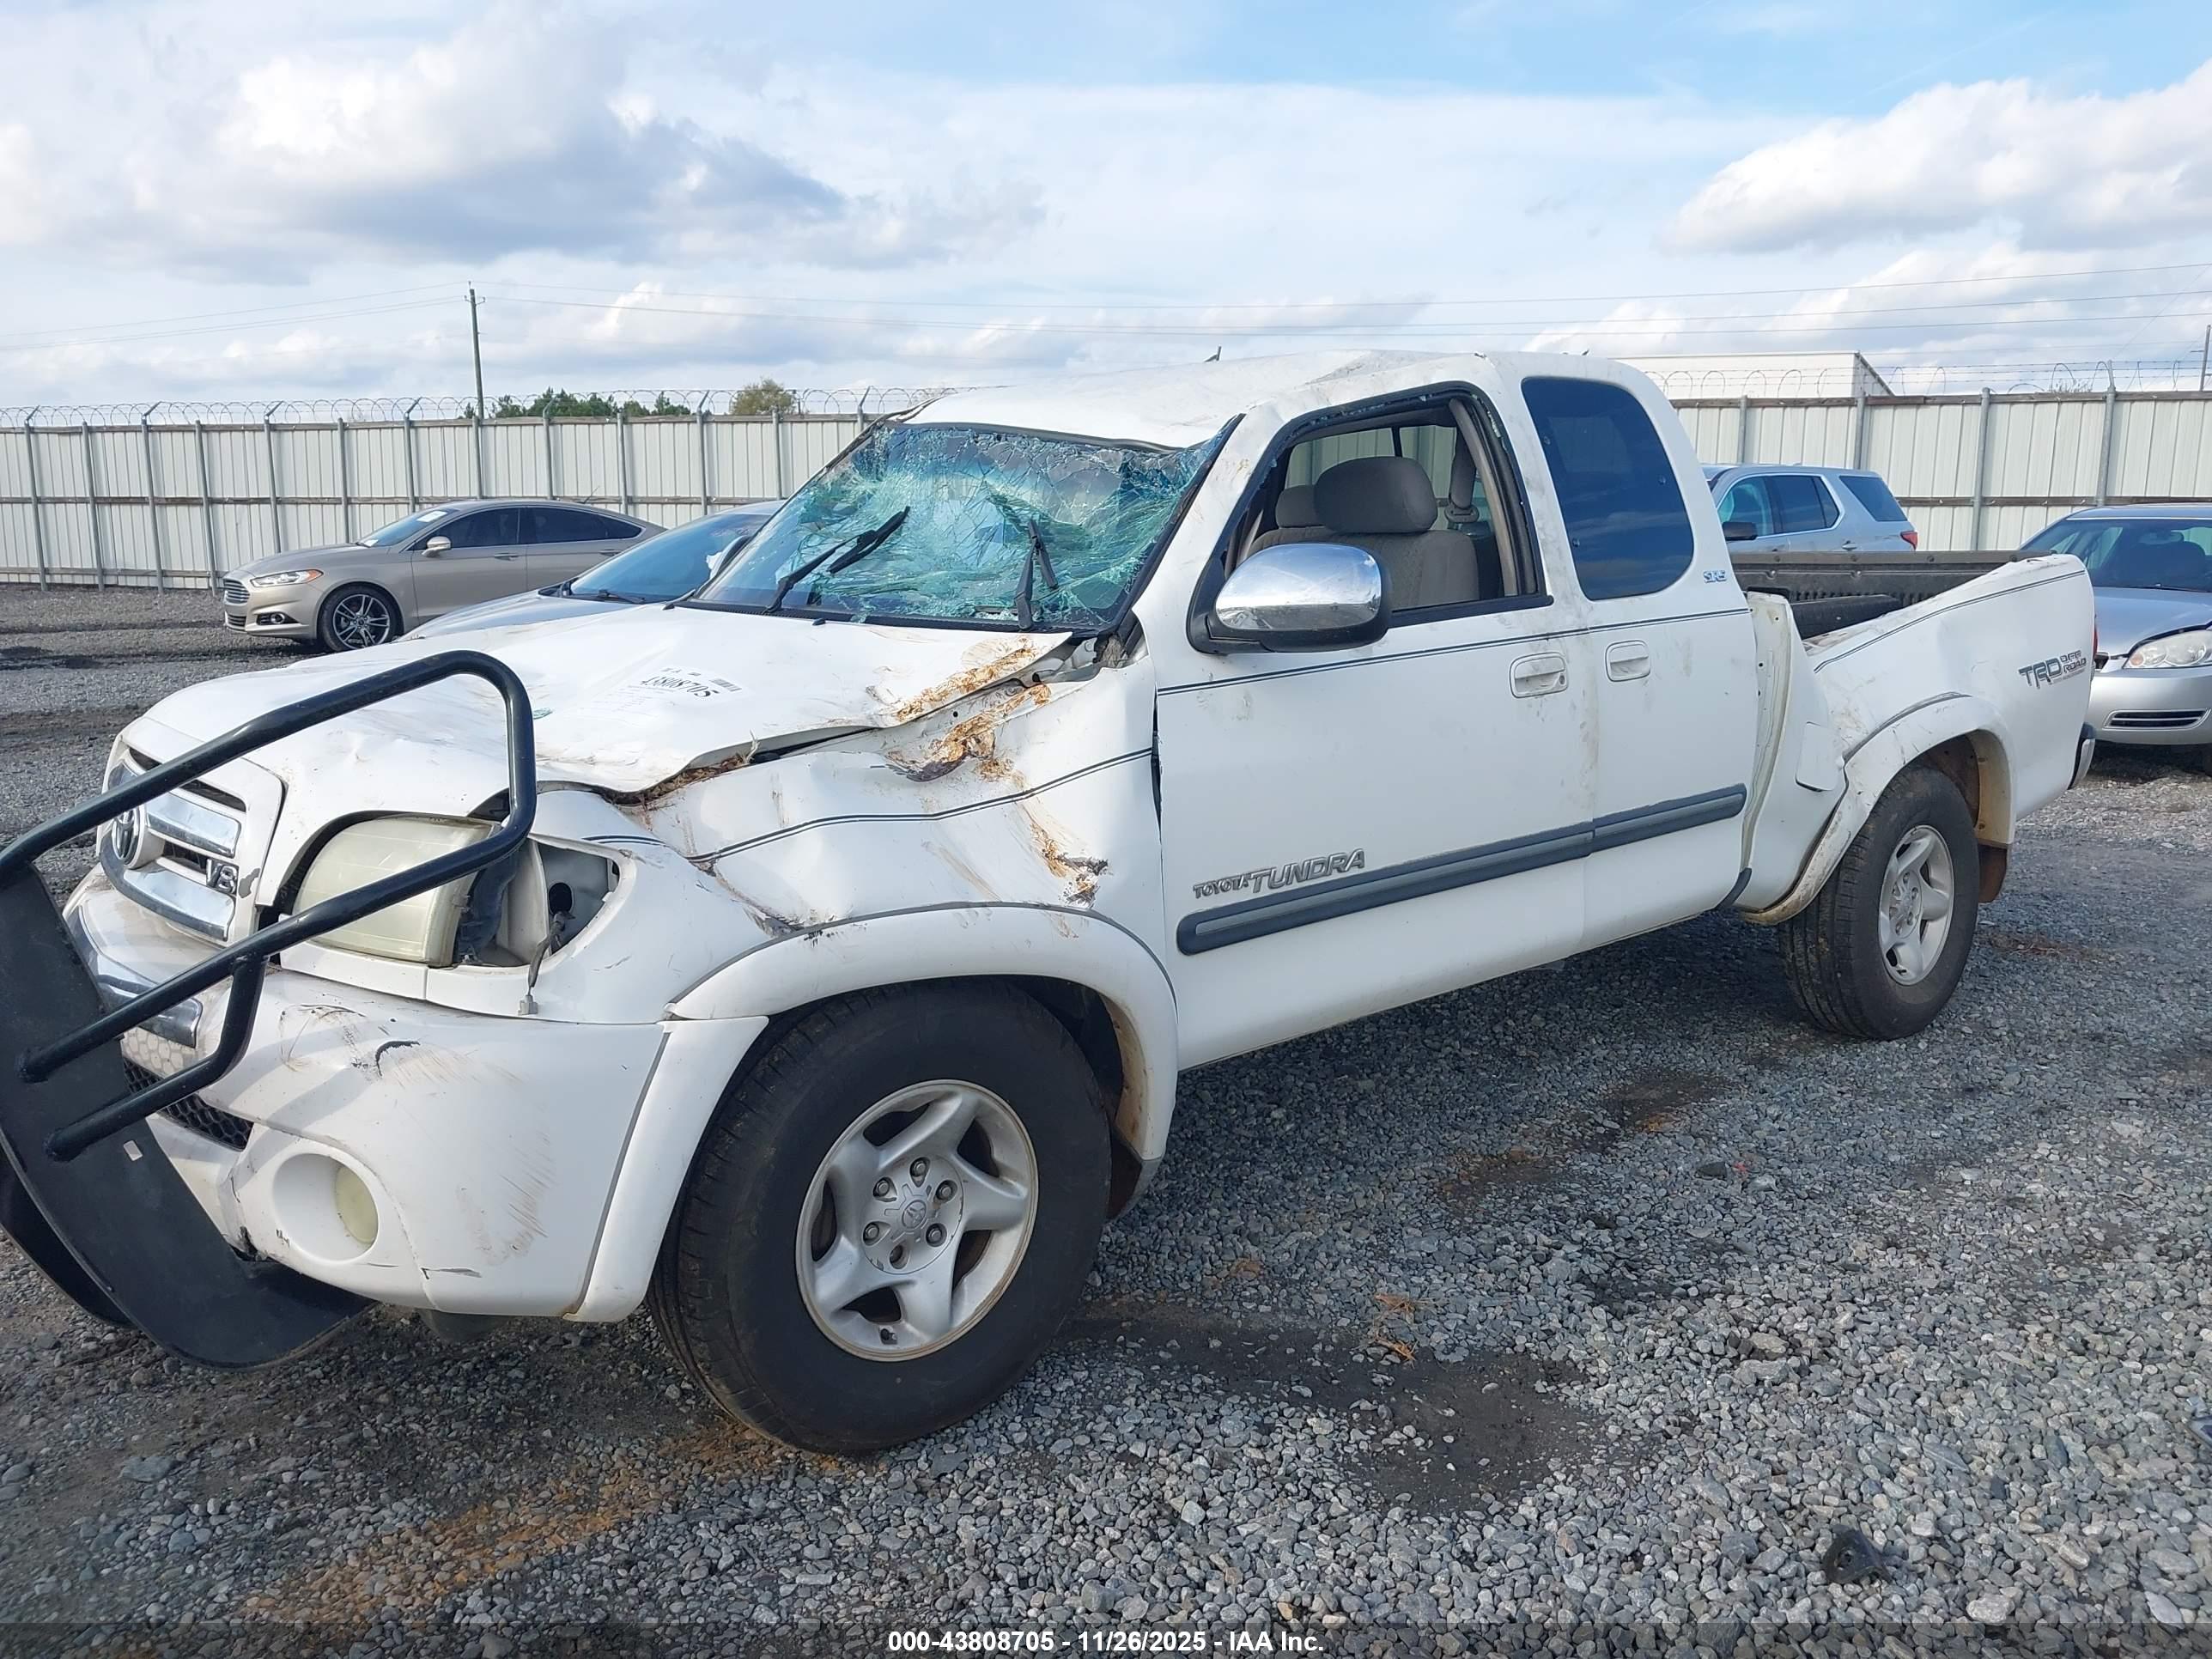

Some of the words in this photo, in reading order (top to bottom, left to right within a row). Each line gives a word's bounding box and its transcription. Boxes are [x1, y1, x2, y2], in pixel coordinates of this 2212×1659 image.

[2018, 657, 2062, 690] TRD
[2060, 650, 2082, 663] OFF
[2063, 658, 2087, 673] ROAD
[206, 859, 239, 895] V8
[1193, 873, 1250, 899] TOYOTA
[1249, 848, 1366, 894] TUNDRA
